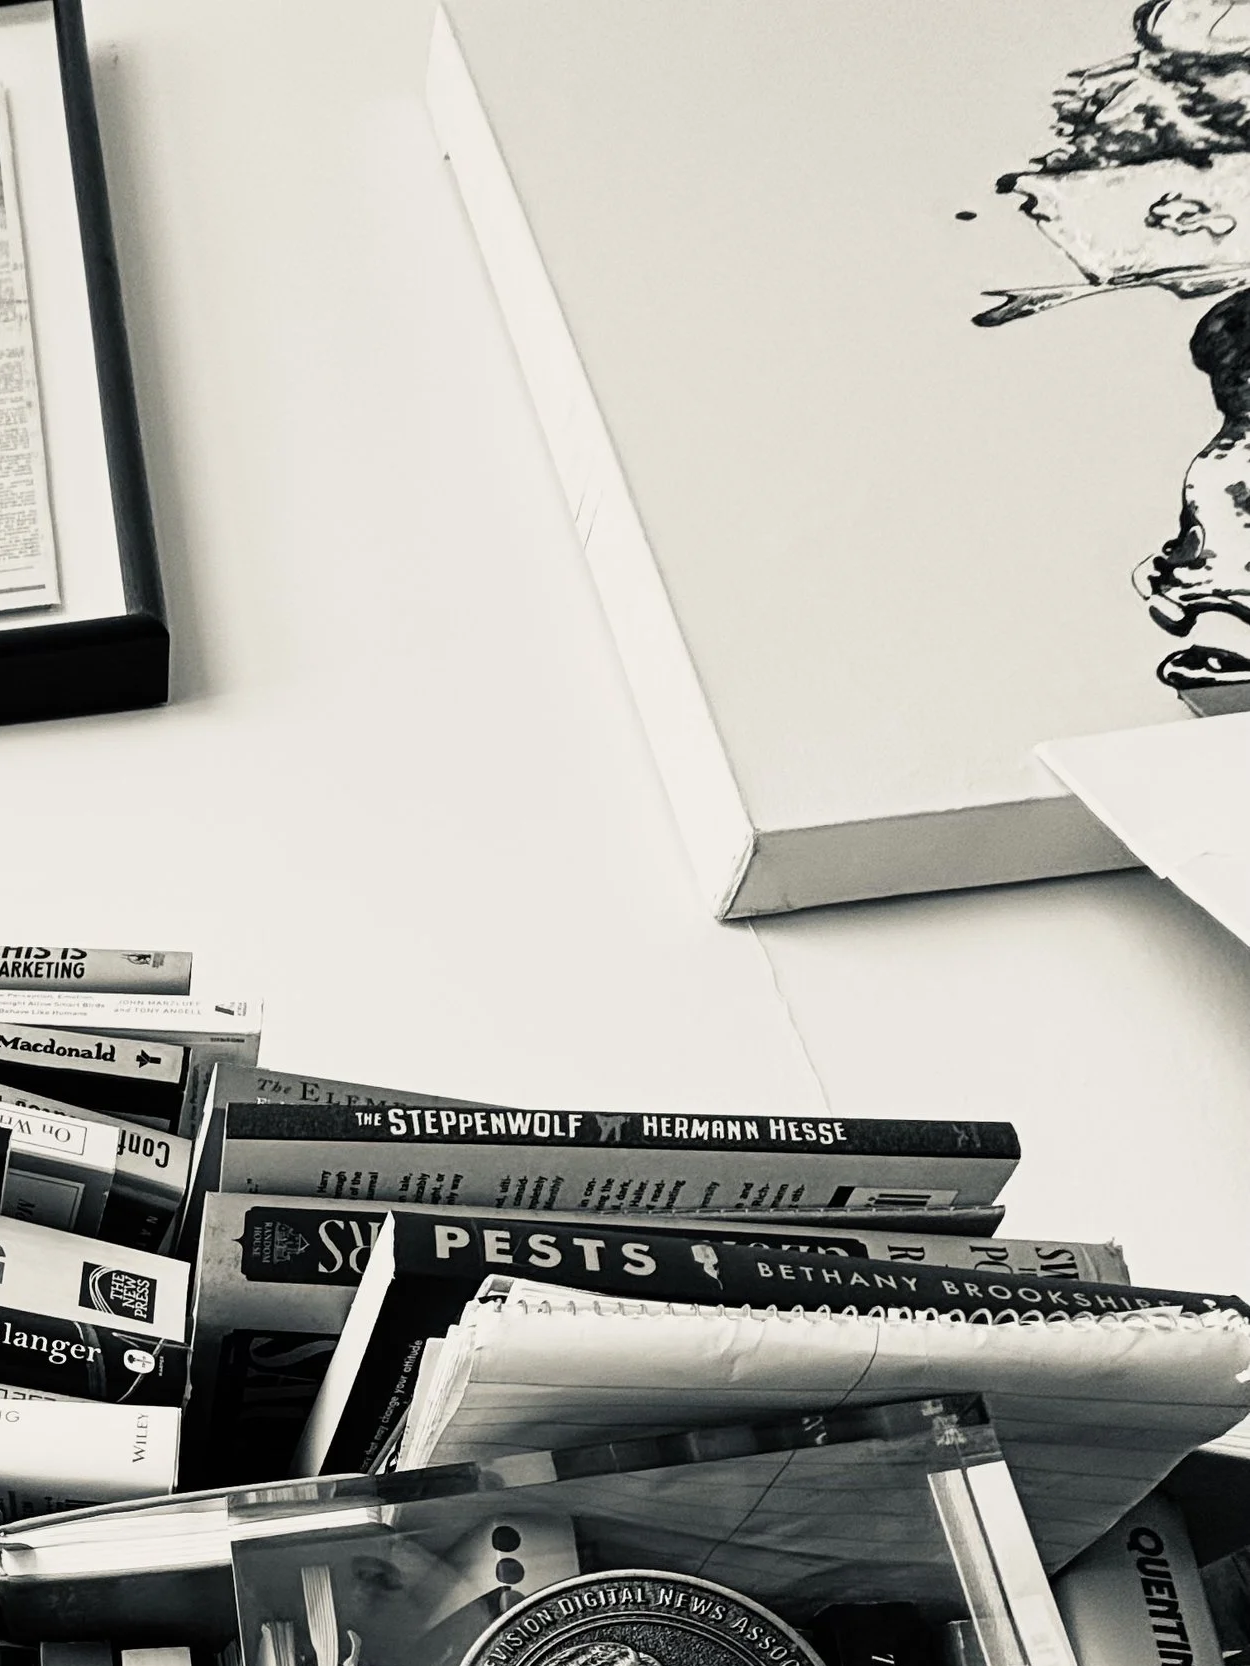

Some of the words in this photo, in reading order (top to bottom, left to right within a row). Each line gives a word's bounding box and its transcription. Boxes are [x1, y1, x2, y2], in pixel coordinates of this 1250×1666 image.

[40, 1122, 73, 1144] On
[355, 1111, 382, 1128] THE
[387, 1107, 585, 1139] STEPPENWOLF
[642, 1114, 759, 1141] HERMANN
[767, 1118, 849, 1145] HESSE
[433, 1223, 659, 1278] PESTS
[755, 1259, 919, 1294] BETHANY
[109, 1272, 125, 1302] THE
[121, 1276, 138, 1310] NEW
[134, 1278, 152, 1319] PRESS
[131, 1411, 151, 1465] WILEY
[556, 1586, 649, 1617] DIGITAL
[656, 1587, 728, 1622] NEWS
